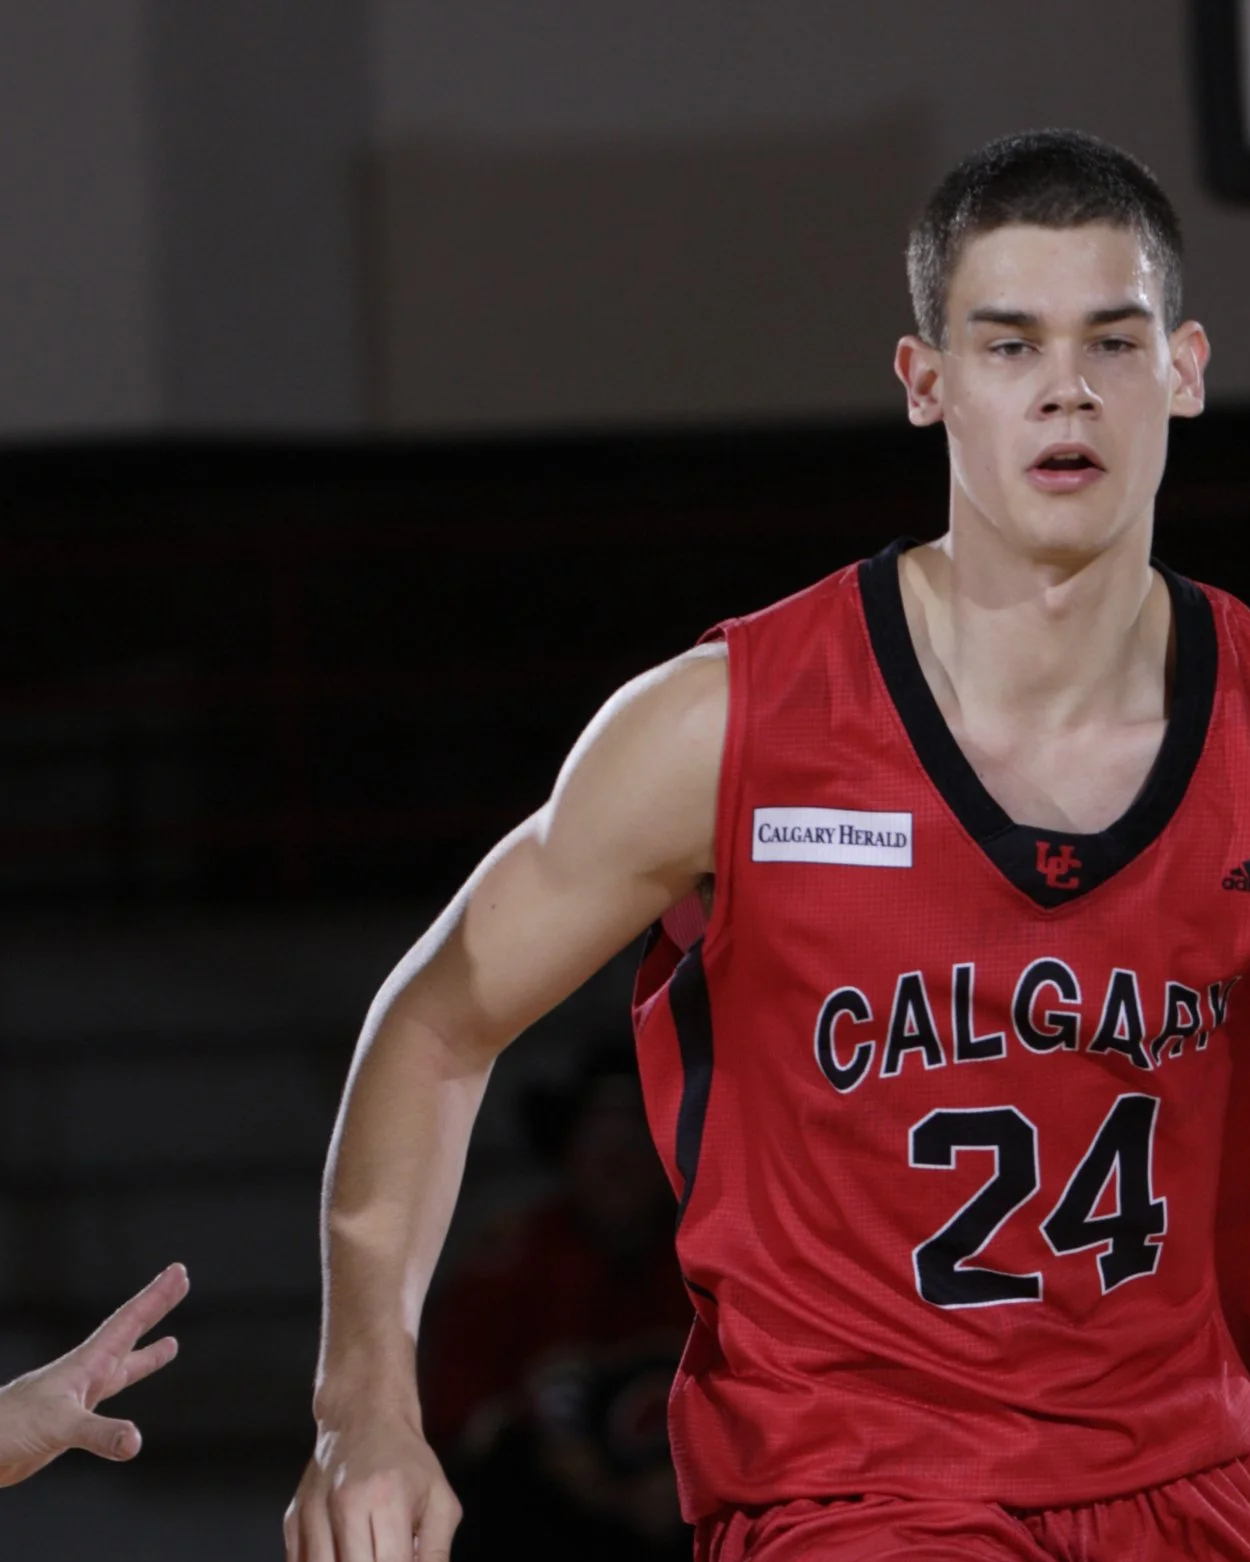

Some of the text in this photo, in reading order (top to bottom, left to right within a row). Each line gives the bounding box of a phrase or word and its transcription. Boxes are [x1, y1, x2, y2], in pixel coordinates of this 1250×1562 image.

[757, 823, 908, 848] CALGARY HERALD
[814, 957, 1243, 1094] CALGARY
[908, 1093, 1168, 1310] 24
